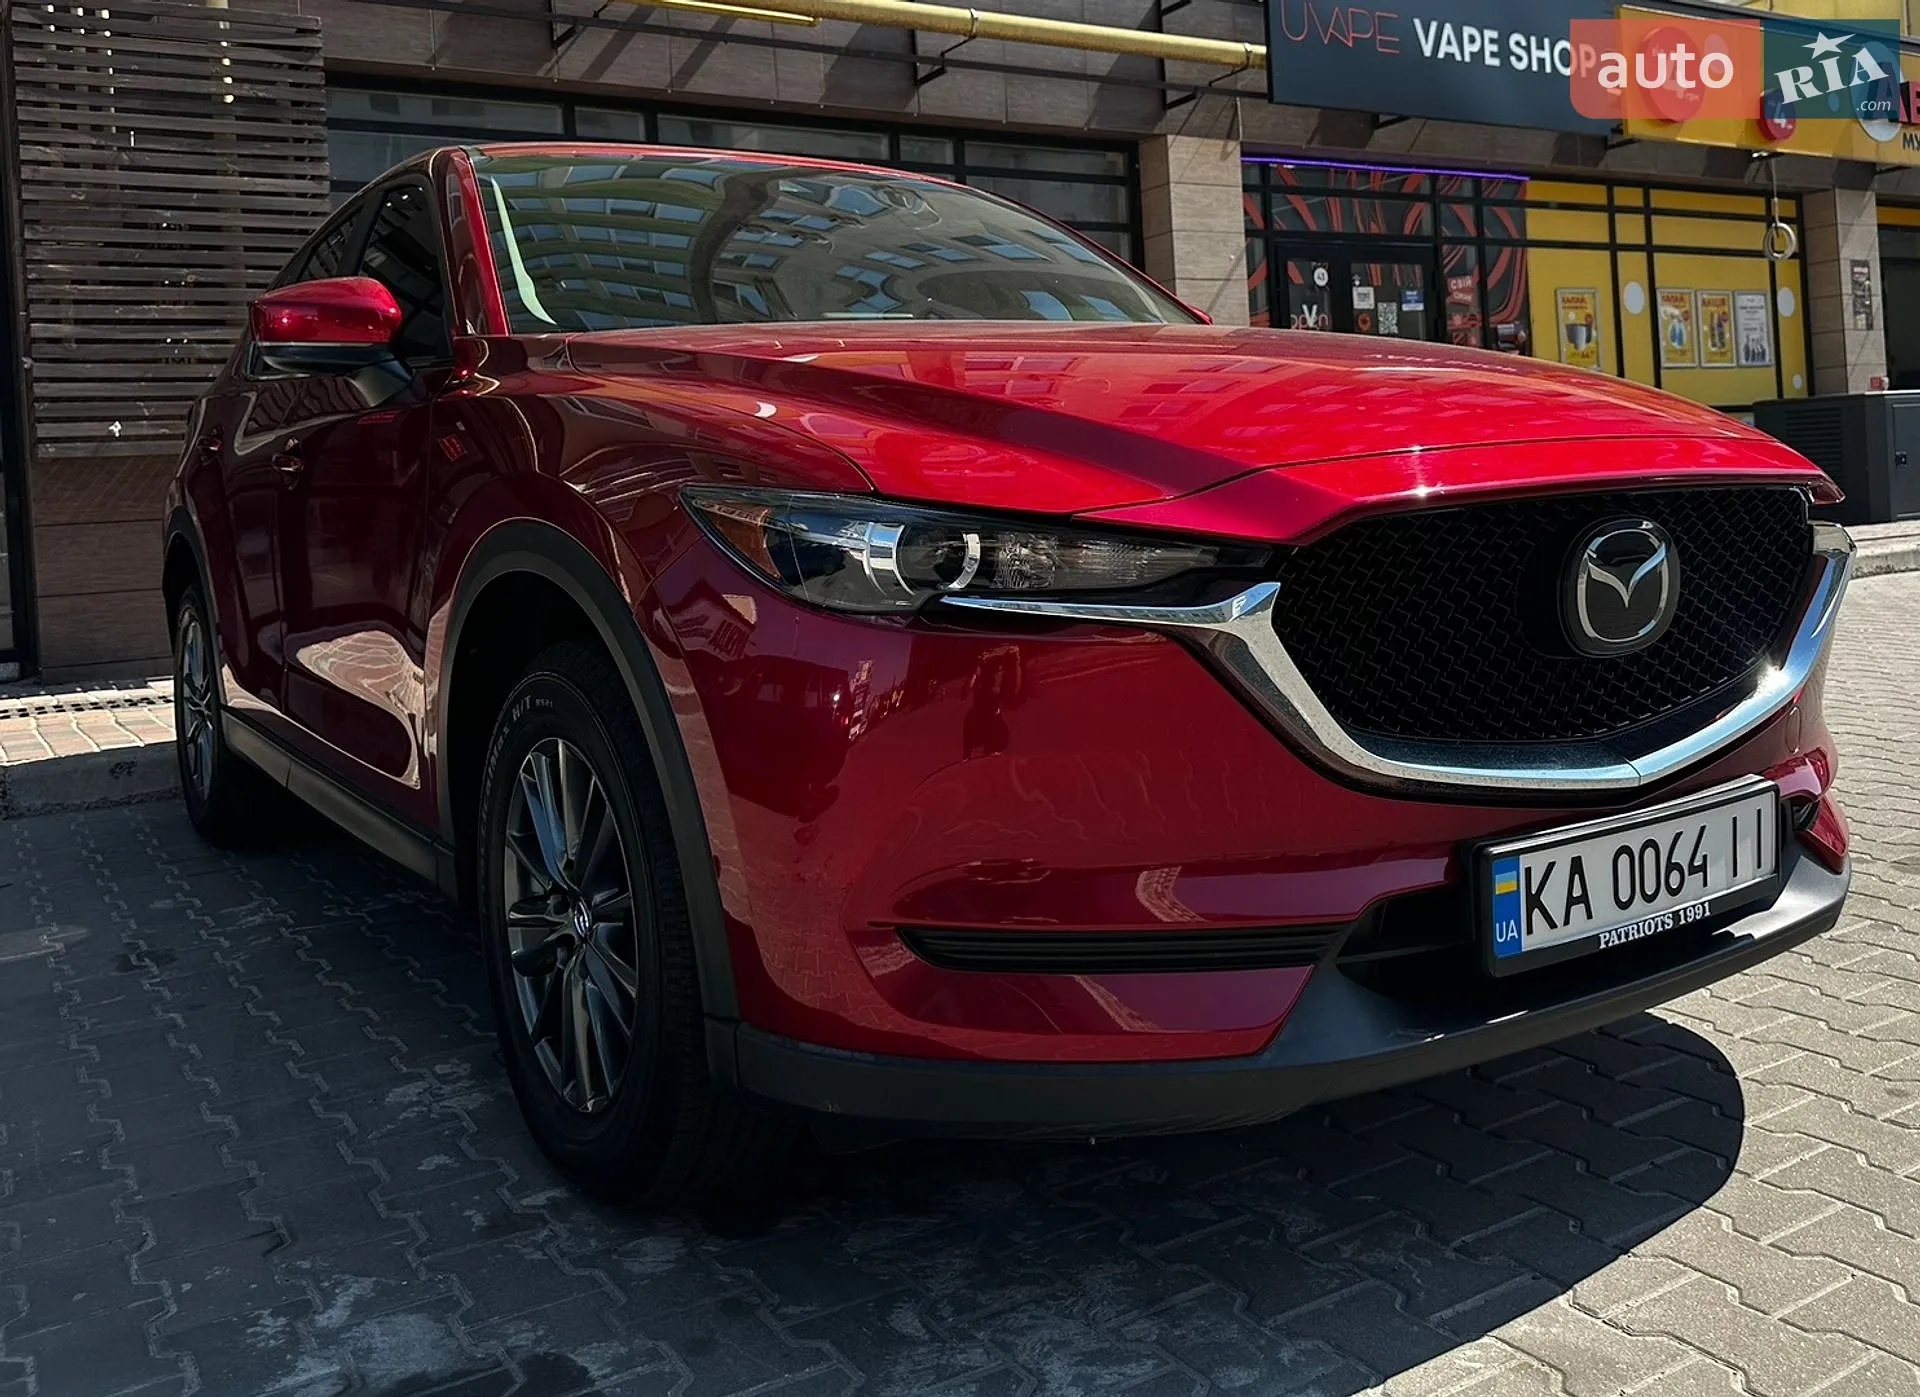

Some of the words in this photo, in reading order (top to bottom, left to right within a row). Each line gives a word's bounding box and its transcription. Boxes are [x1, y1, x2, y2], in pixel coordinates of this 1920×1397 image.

[1413, 17, 1500, 67] VAPE
[1508, 31, 1597, 78] SHOP
[1524, 854, 1594, 936] KA
[1612, 824, 1709, 911] 0064
[1731, 807, 1762, 878] II
[1495, 920, 1518, 943] UA
[1598, 912, 1674, 949] PATRIOTS
[1678, 901, 1711, 924] 1991
